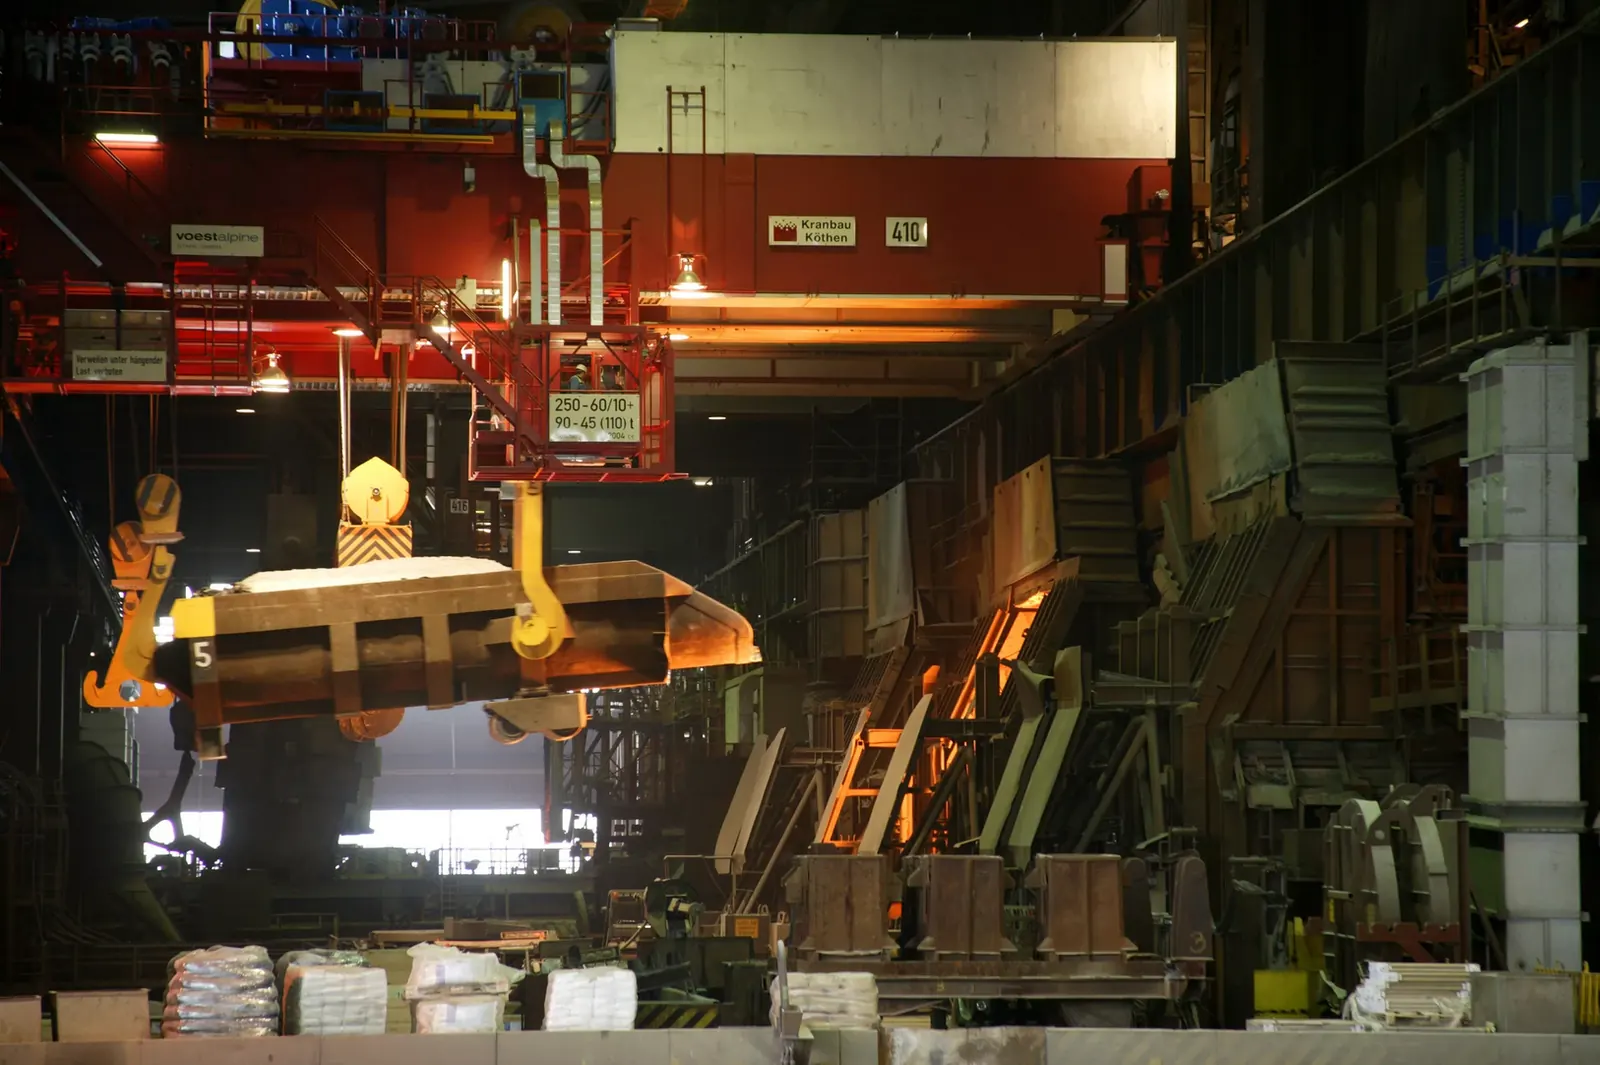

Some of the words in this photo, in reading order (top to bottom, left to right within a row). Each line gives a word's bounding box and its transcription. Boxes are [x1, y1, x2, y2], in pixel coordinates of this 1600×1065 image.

[801, 219, 851, 230] Kranbau
[805, 232, 848, 243] Köthen
[892, 221, 920, 243] 410
[176, 232, 259, 244] voestalpine
[110, 356, 128, 364] unter
[76, 367, 91, 376] Last
[600, 416, 627, 430] (110)
[630, 418, 635, 429] t
[452, 501, 468, 512] 416
[193, 641, 212, 668] 5
[1190, 931, 1207, 955] 3
